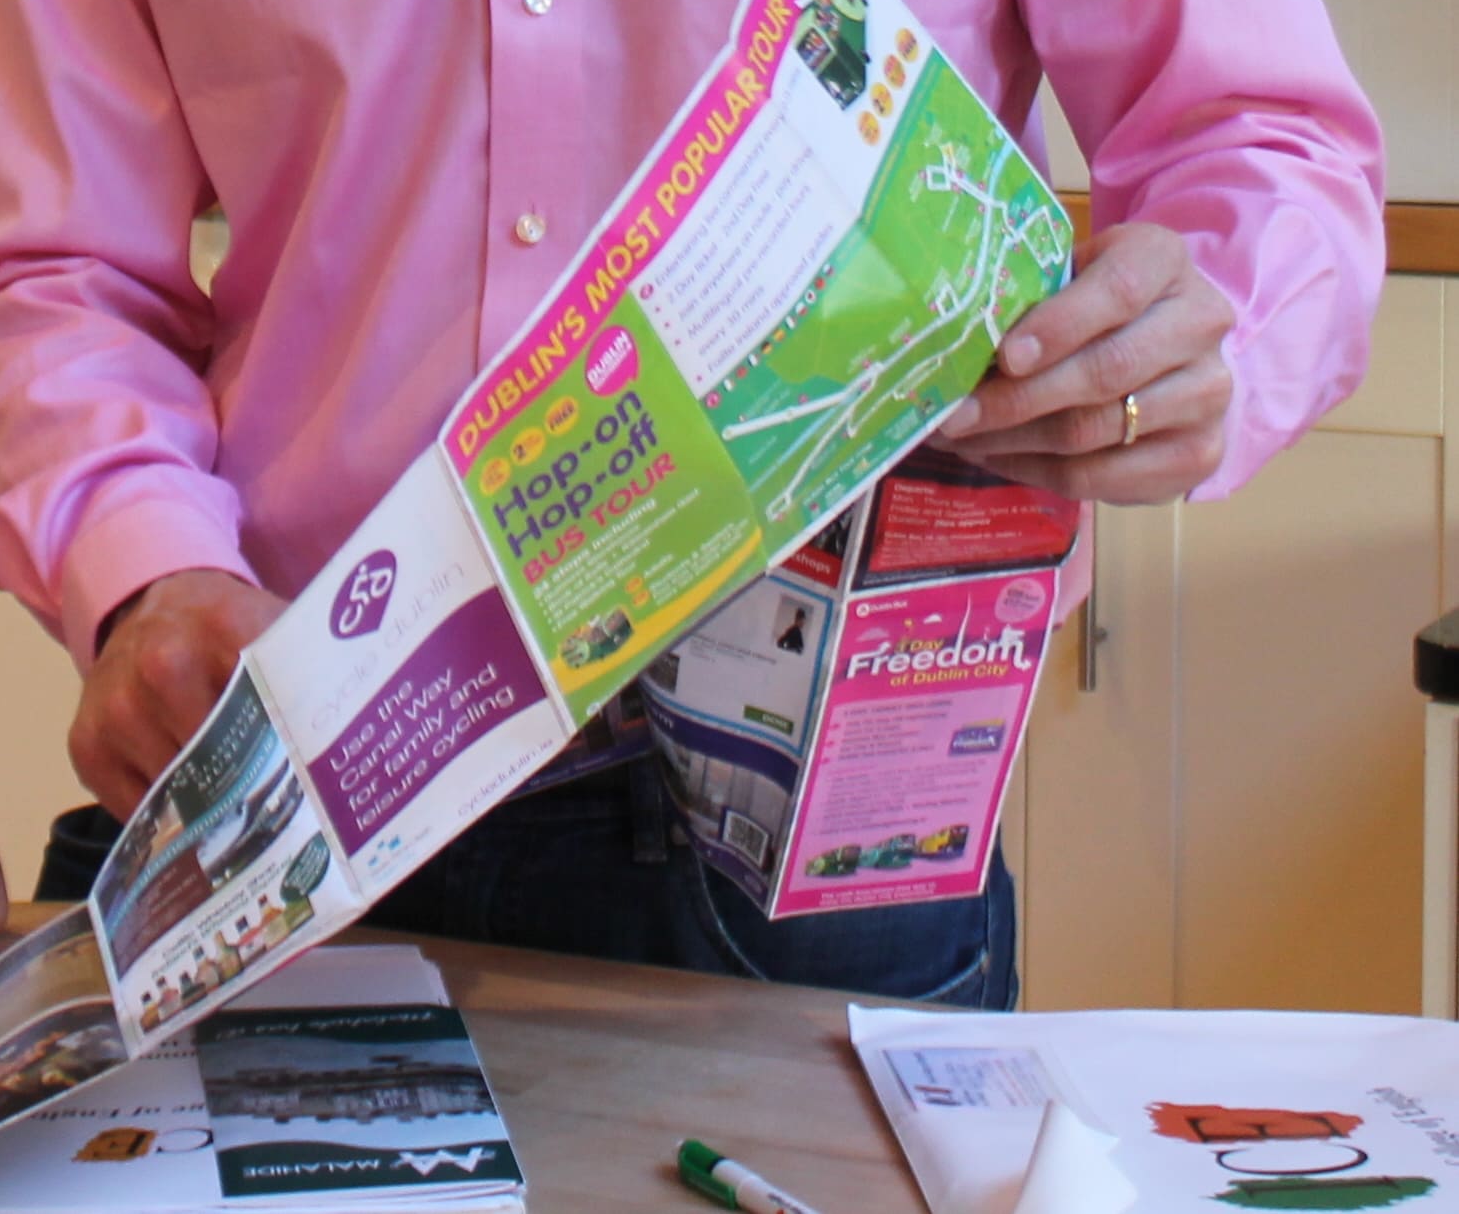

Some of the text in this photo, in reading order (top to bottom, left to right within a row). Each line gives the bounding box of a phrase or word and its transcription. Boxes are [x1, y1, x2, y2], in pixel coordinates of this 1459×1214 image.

[584, 218, 662, 313] MOST
[657, 67, 765, 219] POPULAR
[492, 390, 643, 530] Hop-on
[506, 412, 659, 559] Hop-off
[521, 524, 588, 585] BUS
[589, 451, 678, 526] TOUR
[846, 628, 1032, 681] Freedom
[889, 662, 1009, 686] of Dublin City
[330, 679, 413, 772] Use the
[338, 728, 404, 791] Canal
[404, 667, 456, 730] Way
[347, 662, 498, 813] for family and
[355, 686, 518, 833] leisure cycling
[242, 1160, 382, 1178] MALAHIDE
